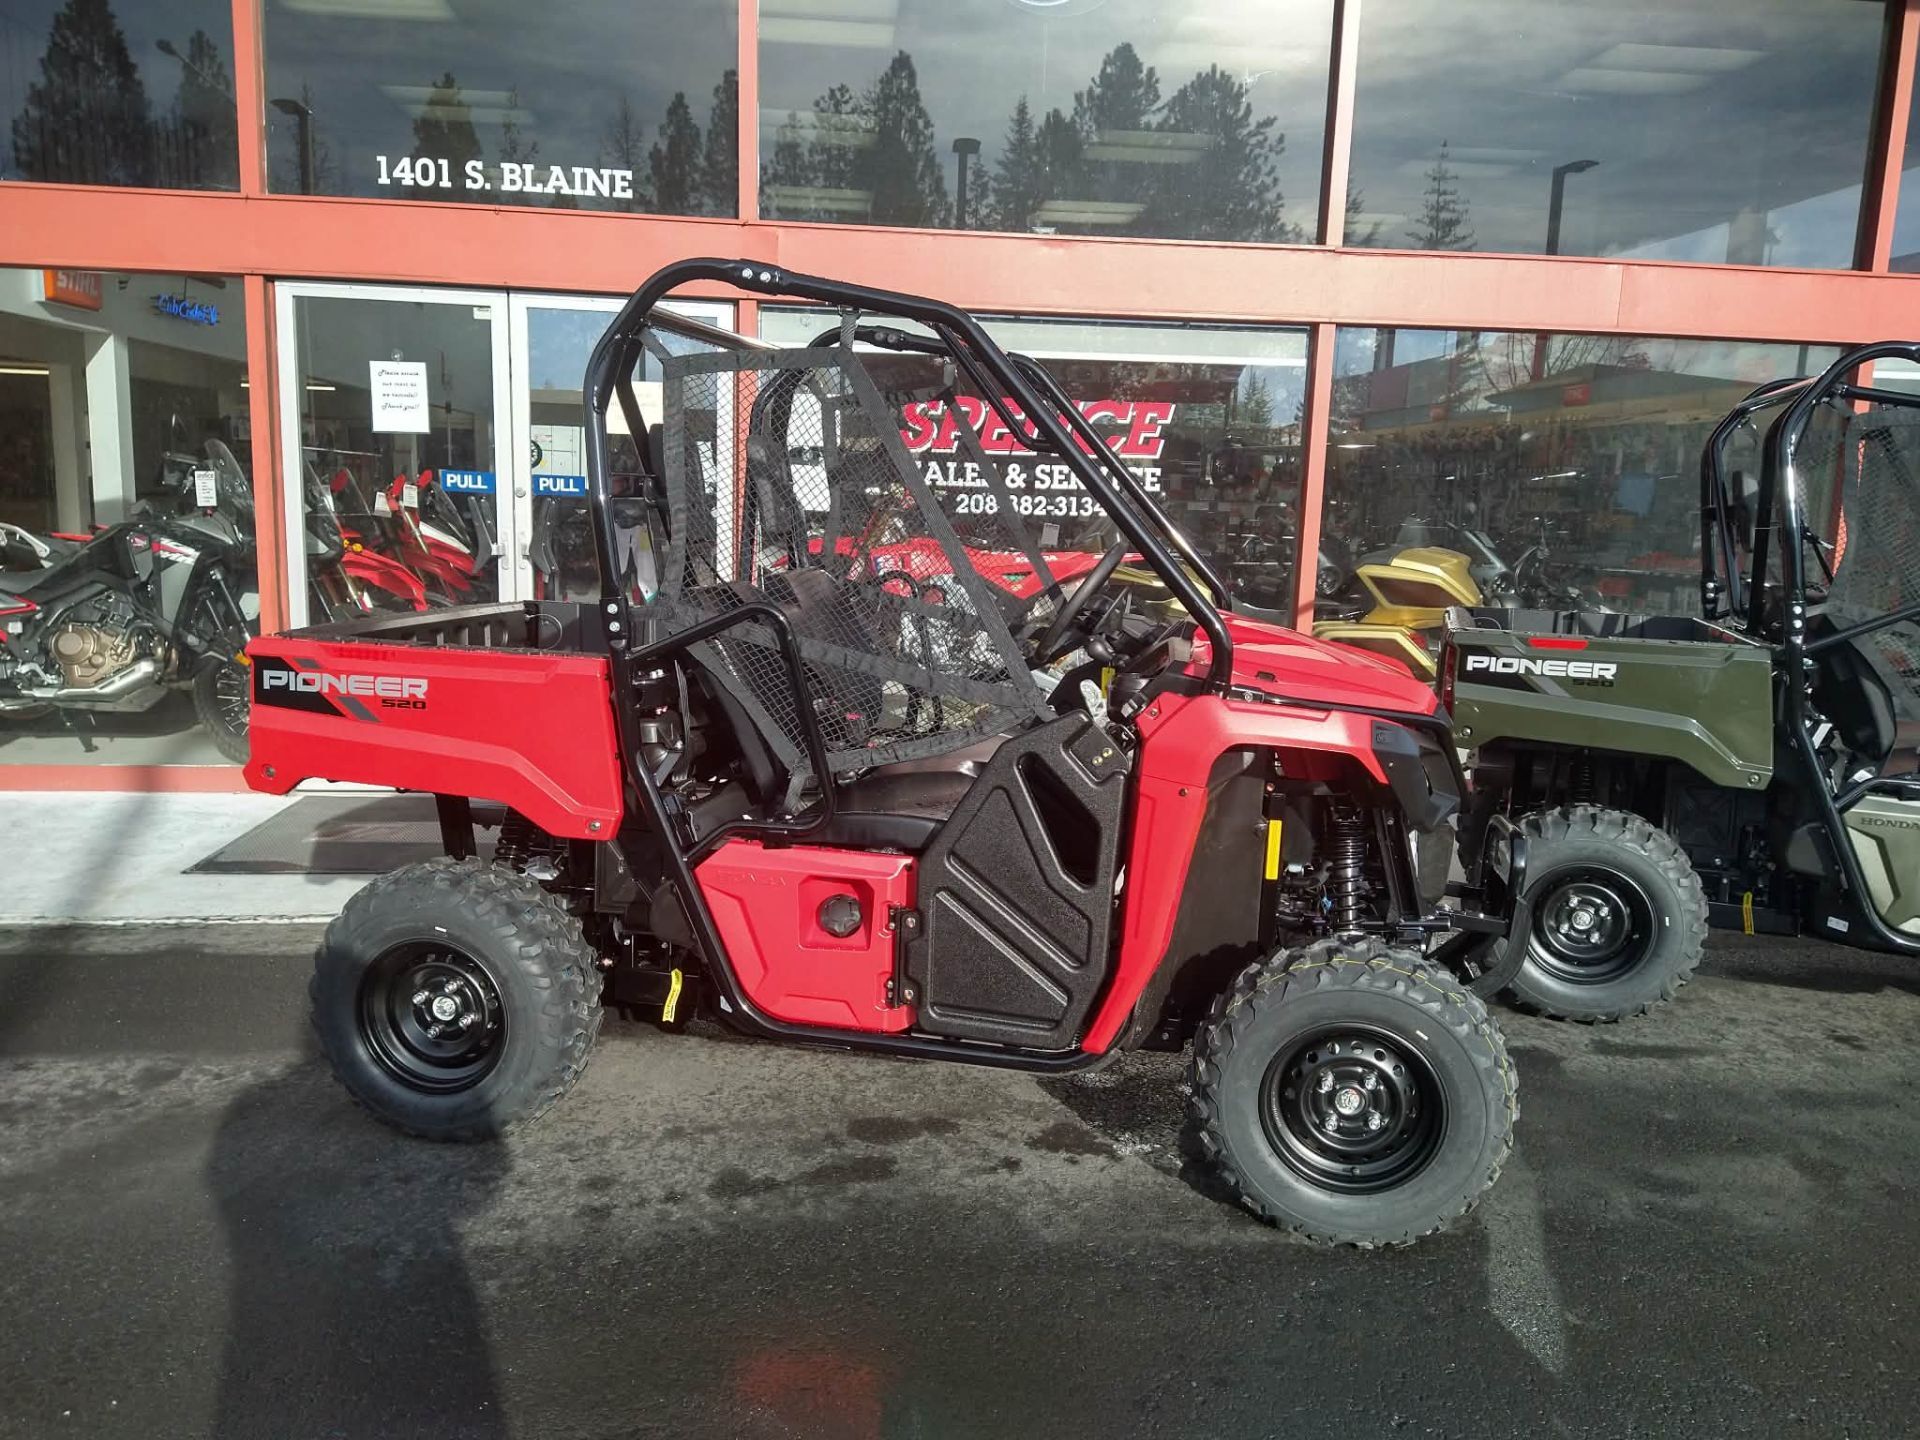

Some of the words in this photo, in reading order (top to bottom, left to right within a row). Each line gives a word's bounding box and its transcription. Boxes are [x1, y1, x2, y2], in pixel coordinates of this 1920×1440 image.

[376, 154, 452, 188] 1401
[464, 160, 491, 190] S.
[500, 162, 634, 199] BLAINE
[899, 395, 1176, 459] SPECE
[446, 473, 488, 490] PULL
[538, 477, 580, 492] PULL
[914, 460, 998, 488] ALE
[1005, 462, 1027, 489] &
[1466, 655, 1618, 680] PIONEER
[262, 669, 429, 699] PIONEER
[1572, 678, 1614, 688] 520
[381, 698, 427, 710] 520
